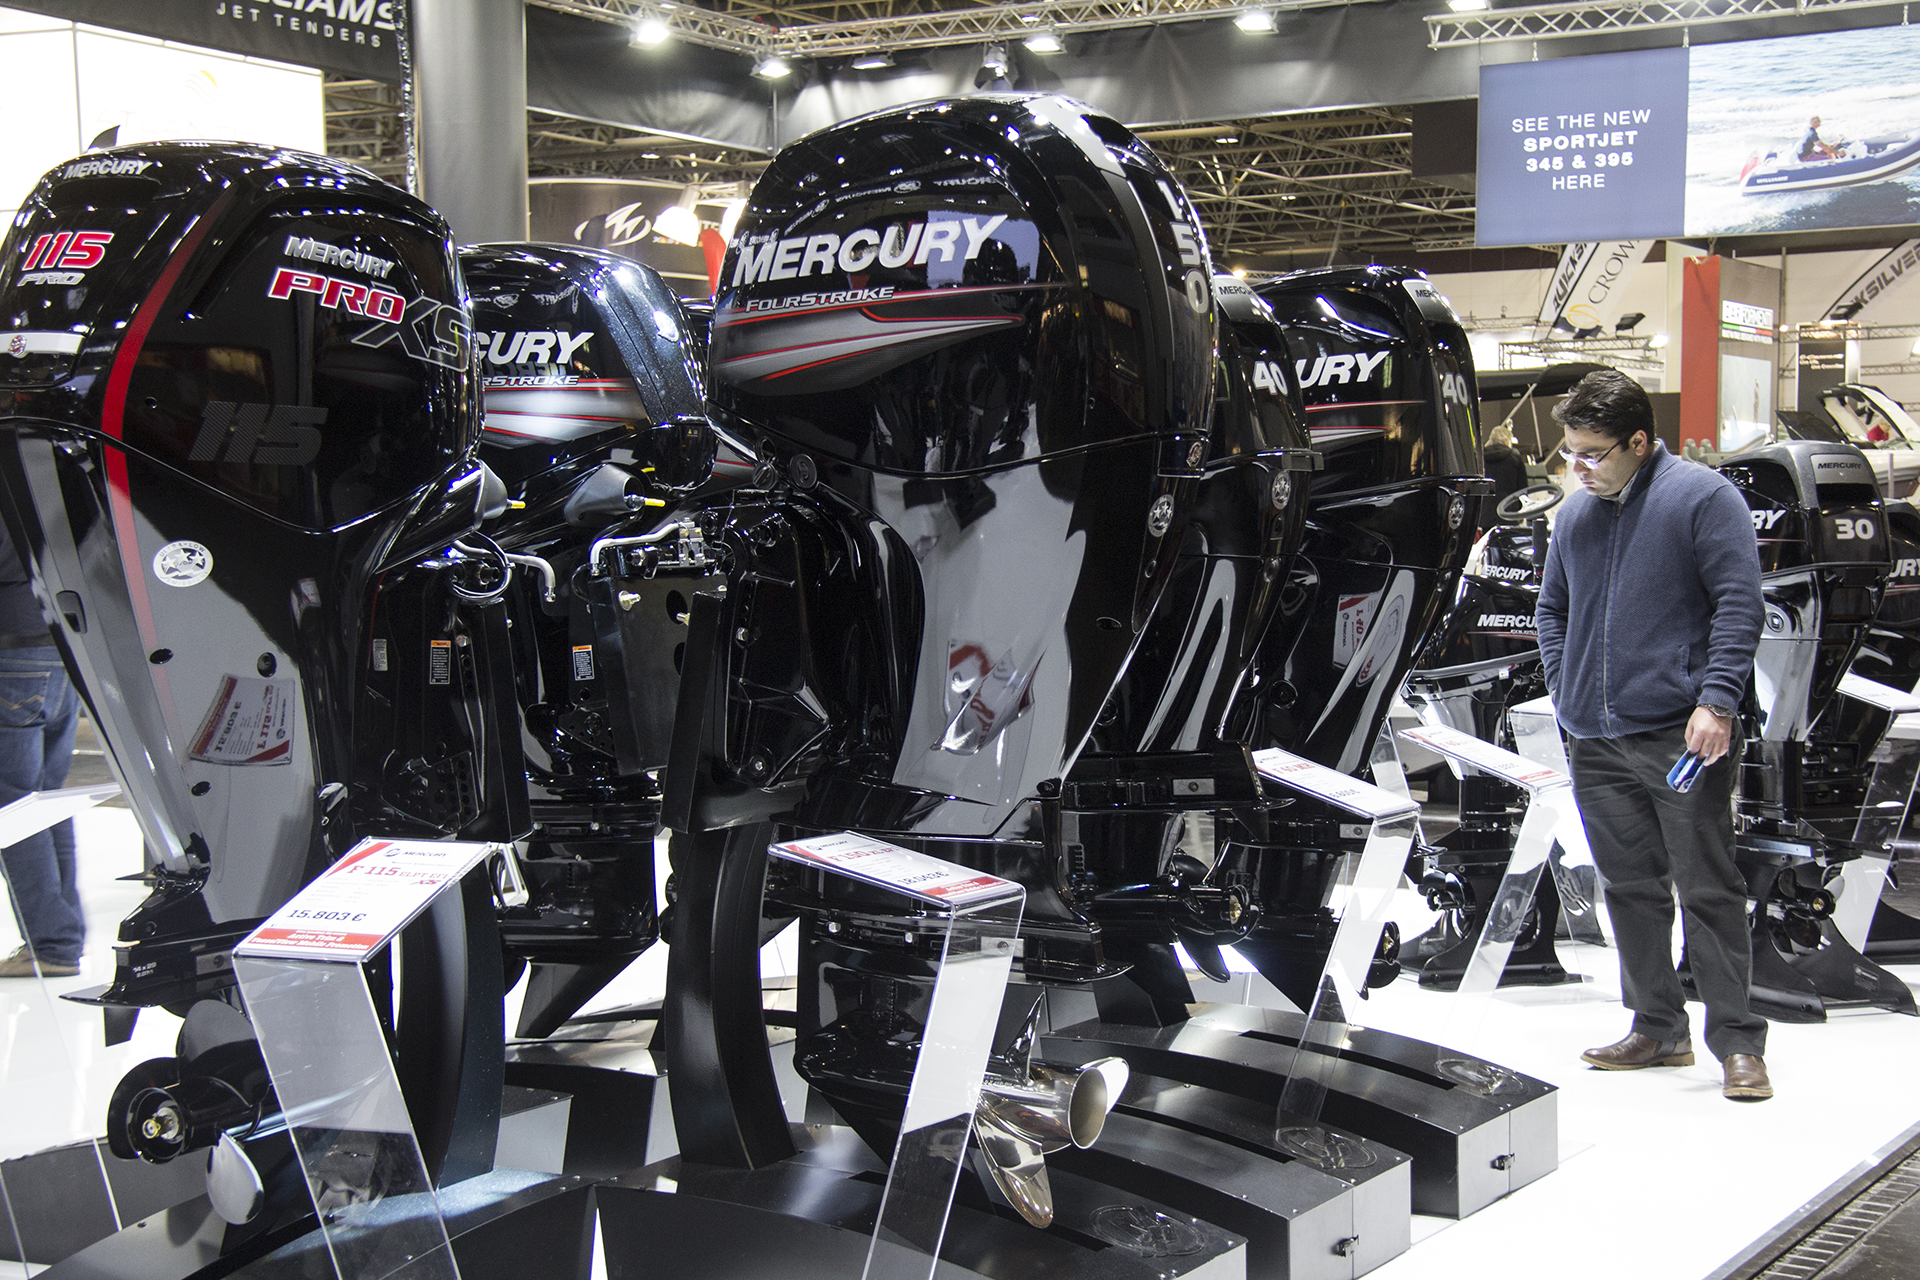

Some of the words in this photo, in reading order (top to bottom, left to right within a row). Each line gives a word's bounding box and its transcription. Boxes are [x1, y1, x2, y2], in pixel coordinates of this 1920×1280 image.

[215, 2, 260, 22] JET
[273, 13, 381, 48] TENDERS
[1511, 116, 1549, 133] SEE
[1556, 112, 1595, 129] THE
[1603, 108, 1651, 127] NEW
[1523, 130, 1638, 152] SPORTJET
[63, 160, 153, 179] MERCURY
[1525, 156, 1564, 172] 345
[1571, 154, 1587, 169] &
[1594, 151, 1634, 168] 395
[1552, 173, 1606, 190] HERE
[21, 231, 115, 271] 115
[284, 235, 395, 279] MERCURY
[731, 213, 1009, 288] MERCURY
[17, 271, 86, 287] PRO
[1588, 240, 1640, 304] CROW
[268, 267, 406, 325] PRO
[745, 286, 895, 312] FOURSTROKE
[1252, 360, 1288, 397] 40
[1441, 372, 1468, 405] 40
[188, 400, 329, 466] 115
[1817, 462, 1862, 470] MERCURY
[1834, 518, 1875, 540] 30
[347, 865, 365, 874] F
[364, 866, 402, 876] 115
[287, 909, 351, 921] 15.803
[351, 913, 367, 922] €
